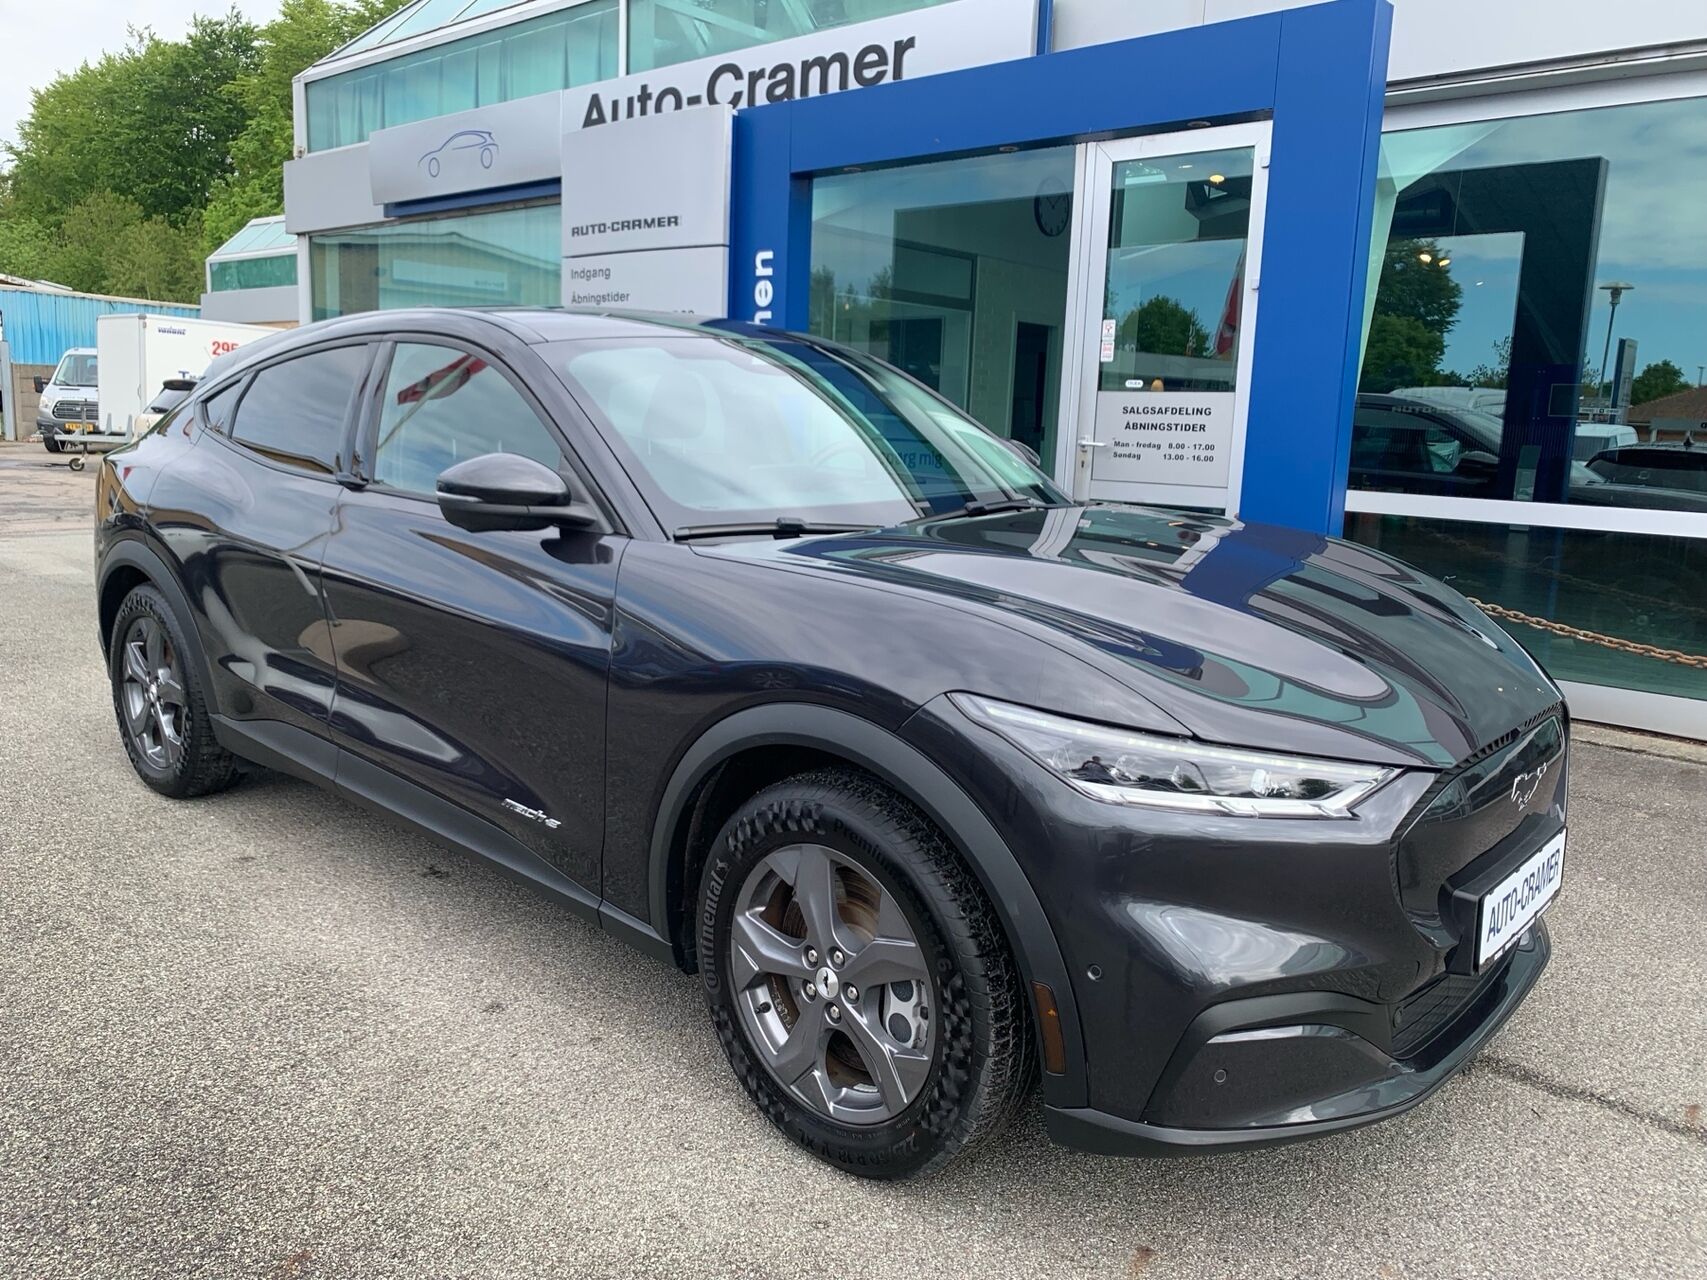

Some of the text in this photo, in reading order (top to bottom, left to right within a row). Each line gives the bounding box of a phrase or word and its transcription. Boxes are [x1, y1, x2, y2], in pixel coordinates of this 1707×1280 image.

[581, 36, 916, 128] Auto-Cramer
[571, 215, 680, 238] AUTO-CRAMER
[570, 267, 612, 282] Indgang
[570, 291, 631, 306] Åbningstider
[1122, 406, 1212, 416] SALGSAFDELING
[1124, 420, 1207, 432] ÅBNINGSTIDER
[1136, 441, 1162, 451] fredag
[1193, 443, 1216, 451] 17.00
[1163, 453, 1185, 461] 13.00
[1192, 454, 1214, 462] 16.00
[1486, 848, 1561, 943] AUTO-CRAMER
[702, 869, 725, 994] Continental
